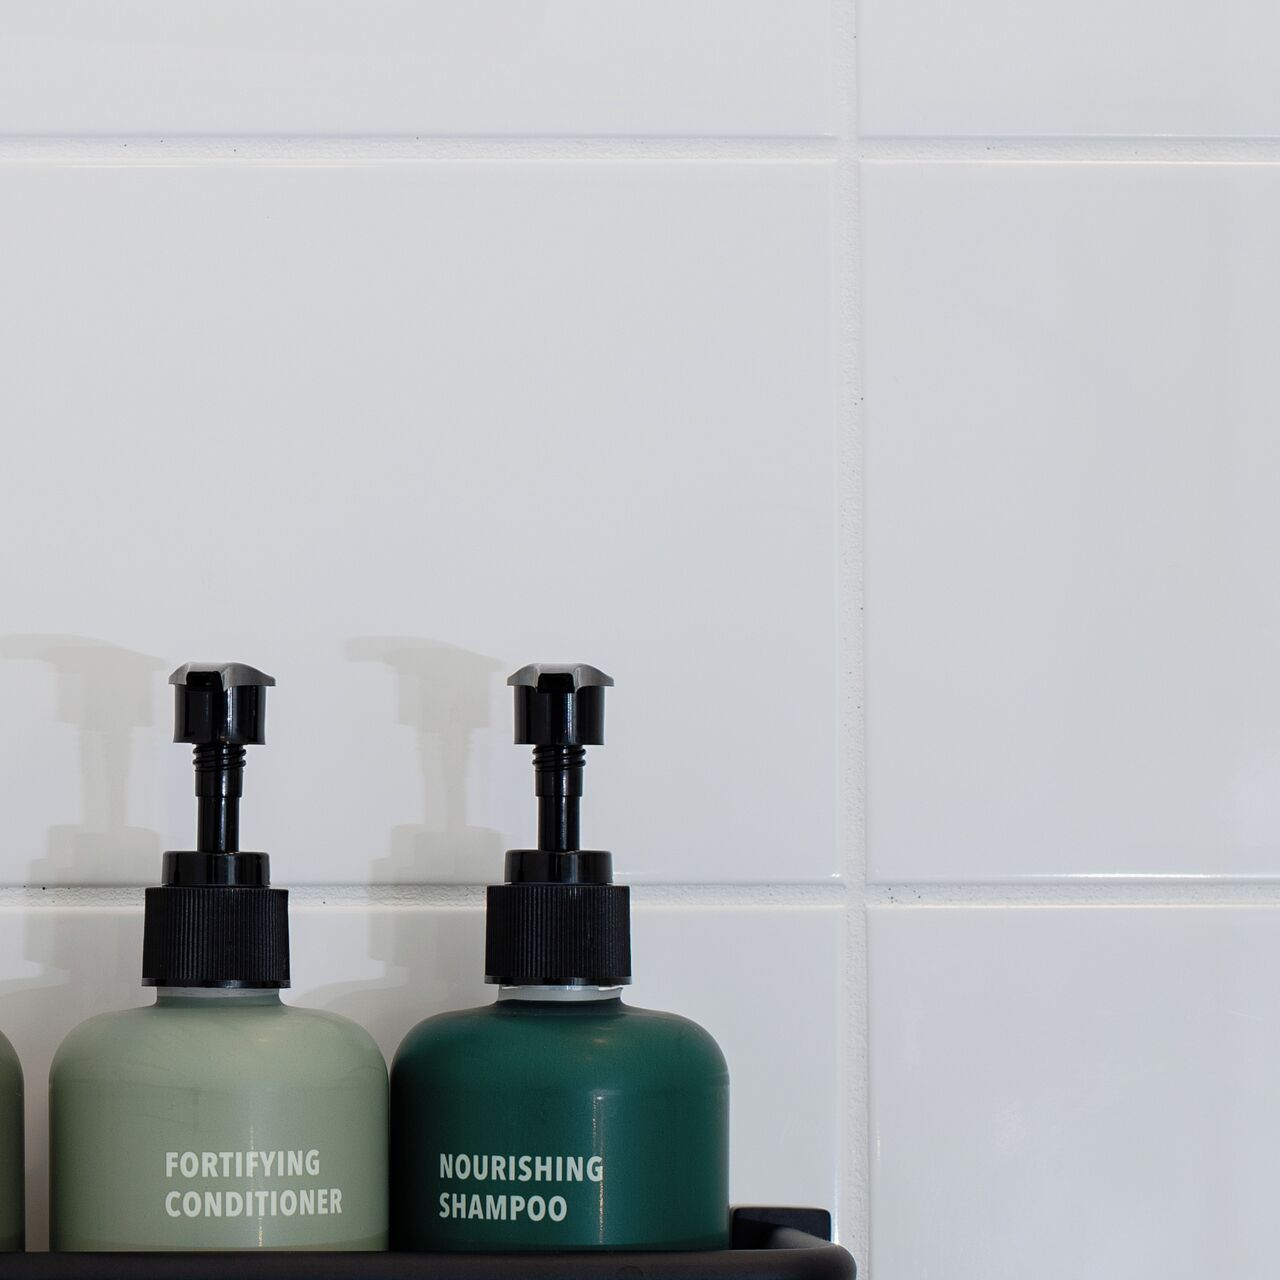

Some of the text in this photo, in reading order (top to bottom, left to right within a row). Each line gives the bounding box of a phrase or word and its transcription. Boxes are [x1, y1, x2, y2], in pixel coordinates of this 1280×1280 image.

[166, 1149, 320, 1178] FORTIFYING
[439, 1153, 604, 1183] NOURISHING
[165, 1187, 342, 1218] CONDITIONER
[439, 1192, 568, 1222] SHAMPOO
